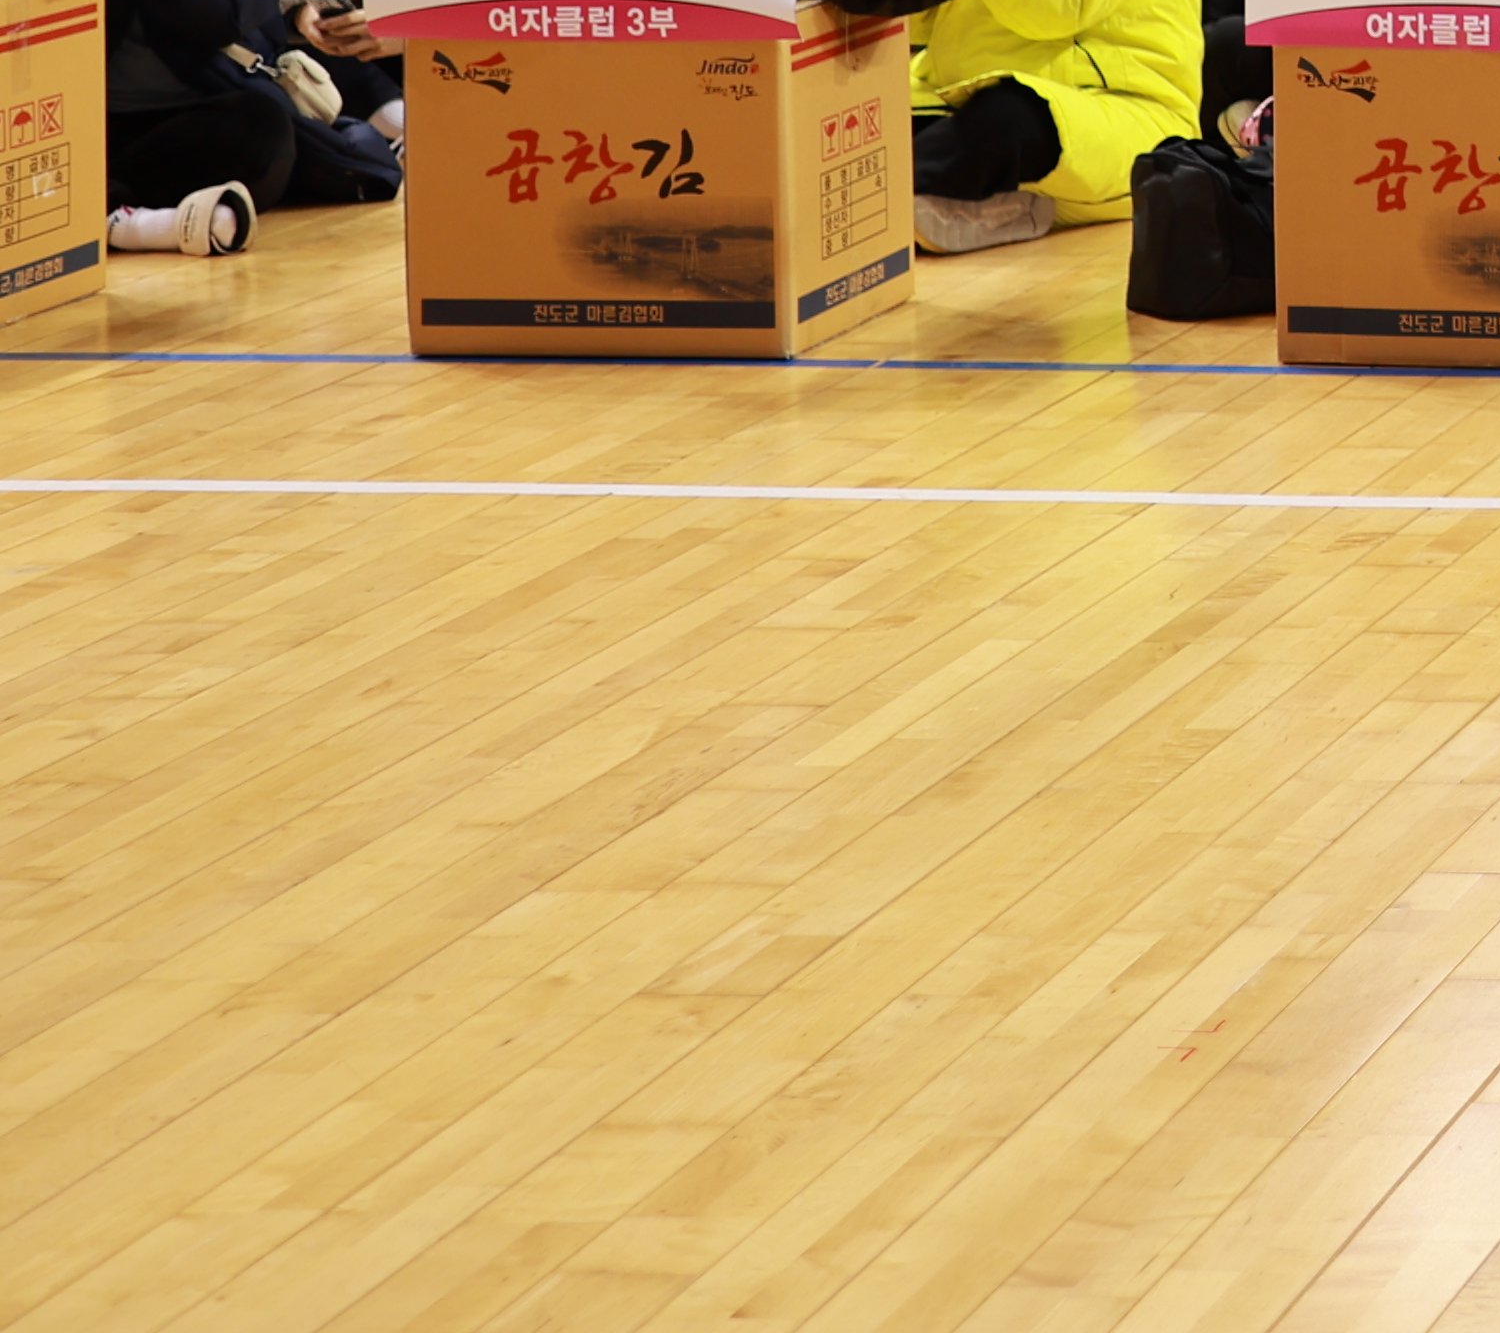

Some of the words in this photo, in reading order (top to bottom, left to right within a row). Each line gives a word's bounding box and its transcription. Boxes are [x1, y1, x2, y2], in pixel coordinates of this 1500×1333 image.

[488, 5, 616, 37] 여자클럽
[627, 6, 678, 37] 3부
[1365, 12, 1492, 46] 여자클럽
[696, 60, 749, 76] Jindo
[486, 129, 705, 204] 곱창김
[533, 305, 579, 323] 진도군
[587, 305, 665, 323] 마른김협회
[1398, 314, 1444, 333] 진도군
